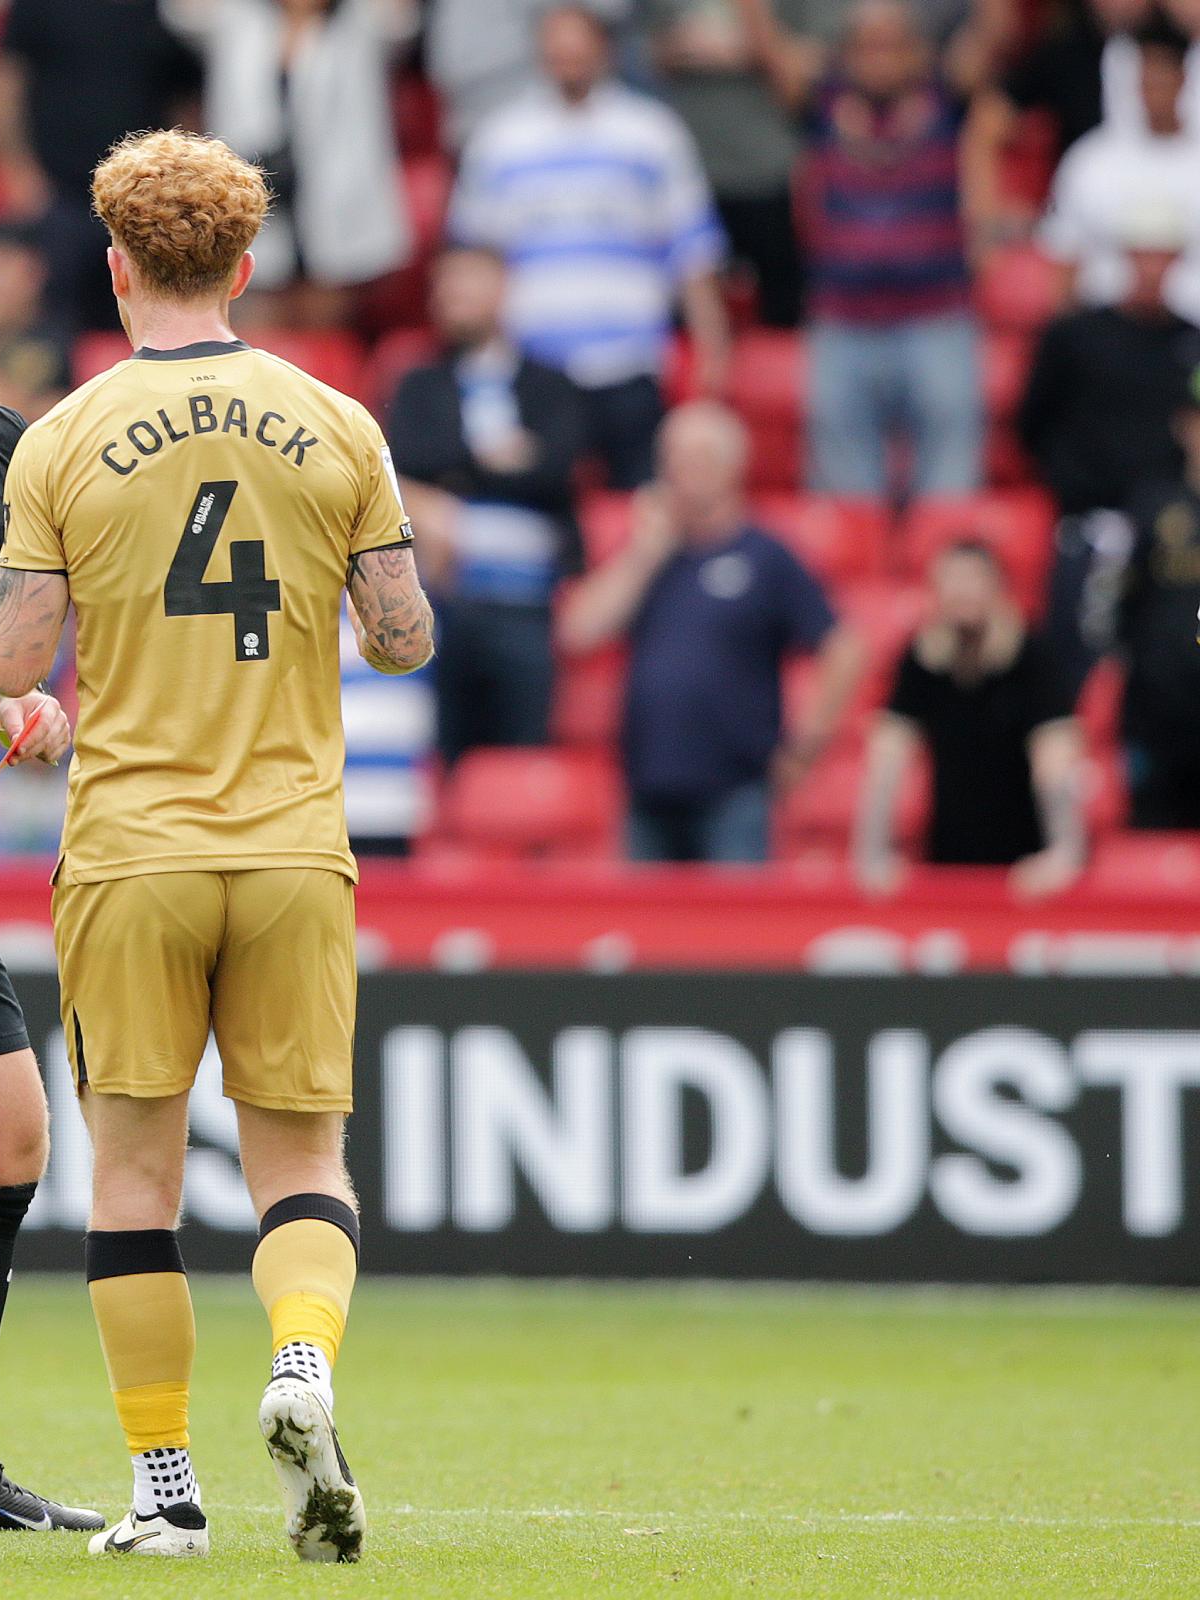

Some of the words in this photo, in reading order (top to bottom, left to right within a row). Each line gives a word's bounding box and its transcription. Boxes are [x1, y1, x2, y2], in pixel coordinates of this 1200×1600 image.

[101, 395, 318, 475] COLBACK
[164, 480, 280, 661] 4
[381, 1025, 1200, 1237] INDUST
